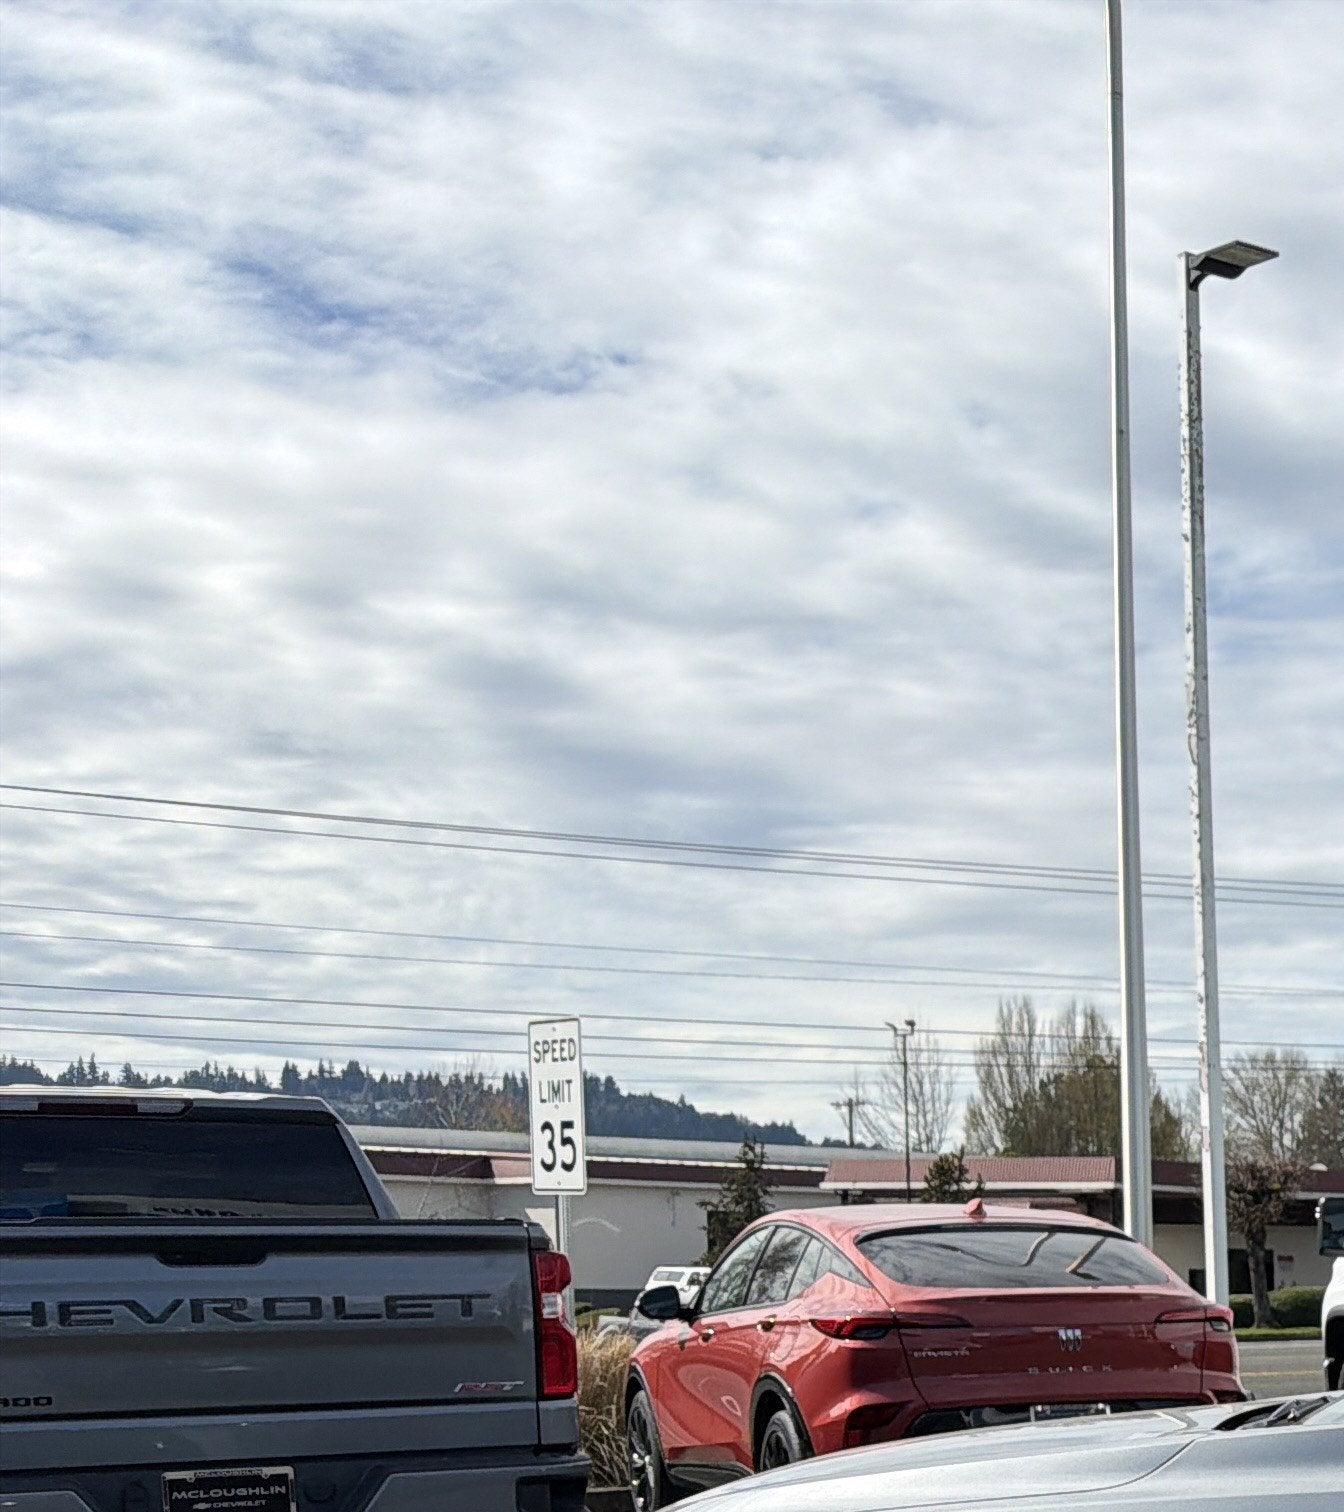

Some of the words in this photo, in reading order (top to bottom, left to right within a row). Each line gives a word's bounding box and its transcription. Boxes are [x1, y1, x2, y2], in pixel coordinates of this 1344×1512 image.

[533, 1037, 577, 1064] SPEED
[538, 1079, 573, 1104] LIMIT
[540, 1120, 577, 1173] 35
[171, 1485, 287, 1500] MCLOUGHLIN
